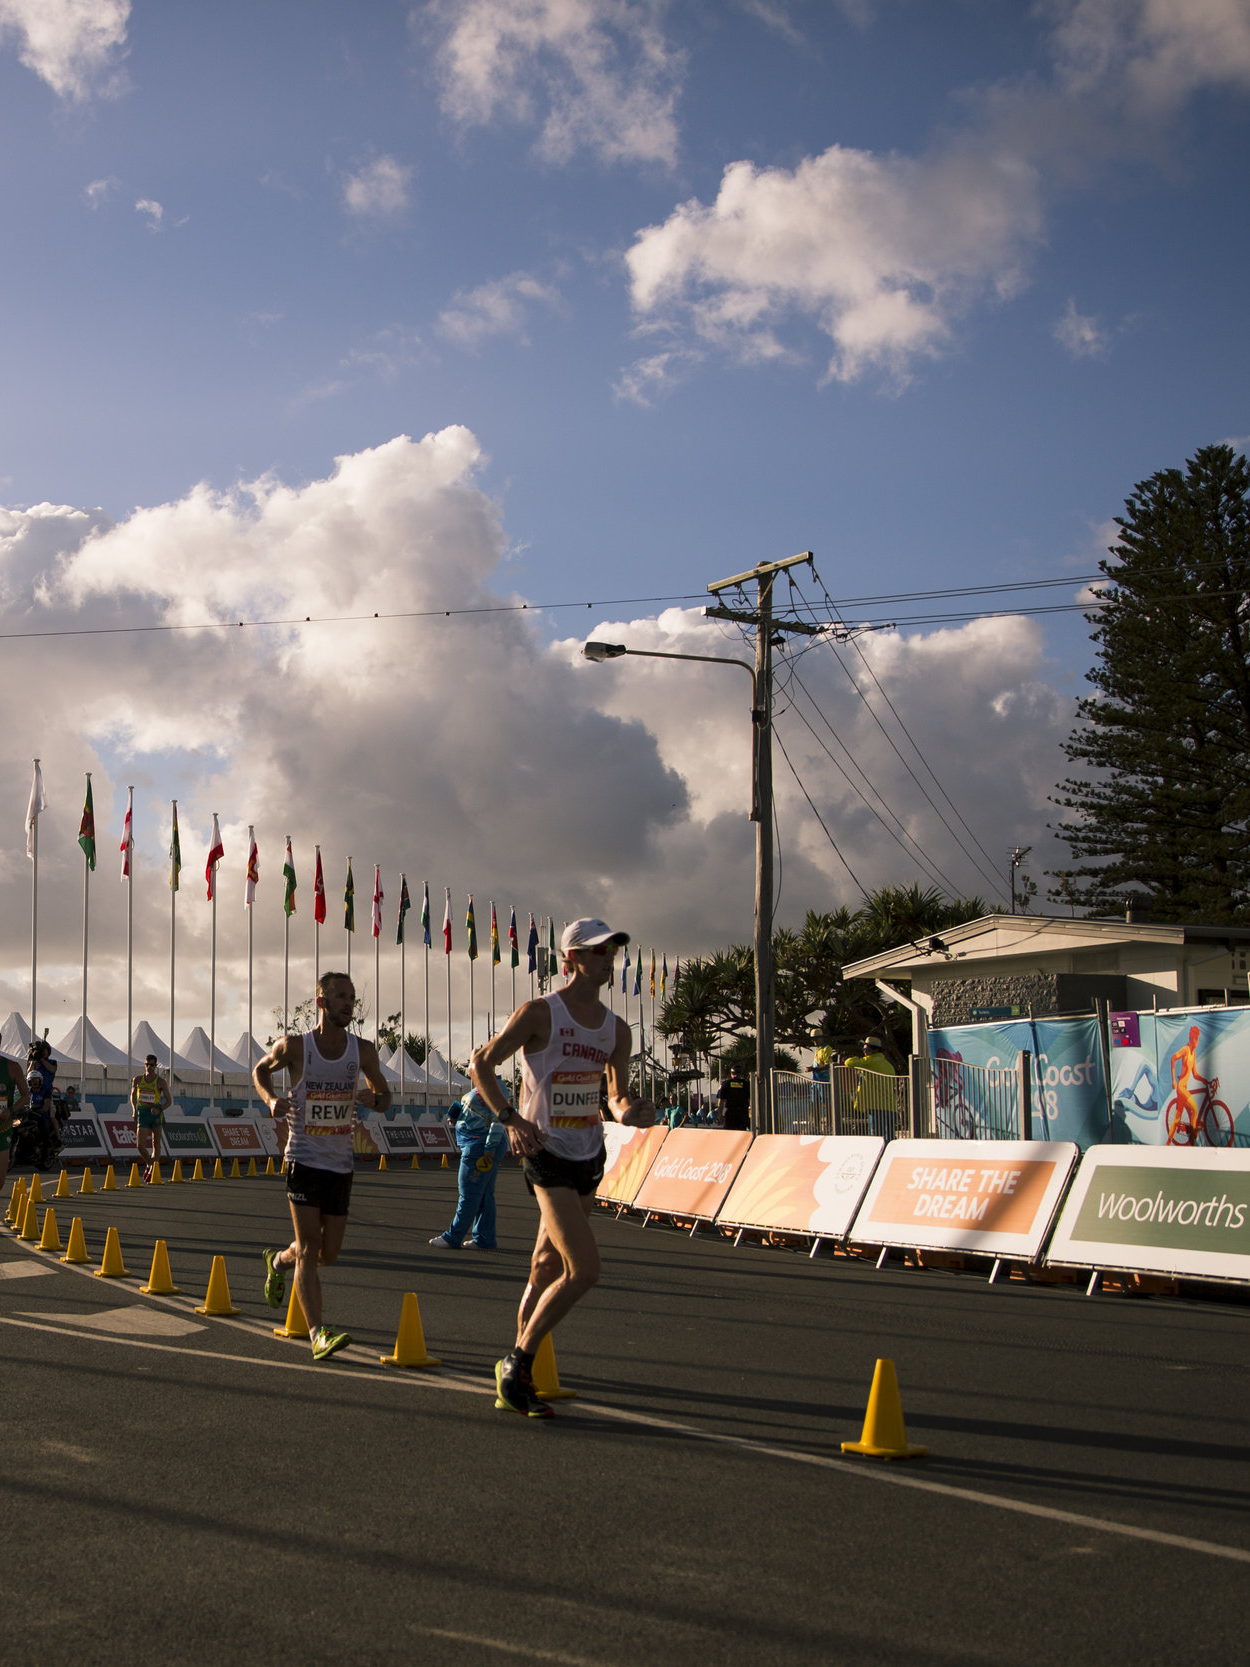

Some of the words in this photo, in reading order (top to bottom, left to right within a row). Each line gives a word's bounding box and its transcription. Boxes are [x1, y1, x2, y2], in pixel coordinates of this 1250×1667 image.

[306, 1081, 323, 1091] NEW
[553, 1091, 599, 1106] DUNFEE
[311, 1104, 350, 1120] REW
[70, 1124, 96, 1137] STAR
[654, 1156, 683, 1180] Gold
[678, 1157, 710, 1182] Coast
[906, 1166, 976, 1193] SHARE
[976, 1169, 1021, 1195] THE
[912, 1193, 990, 1221] DREAM
